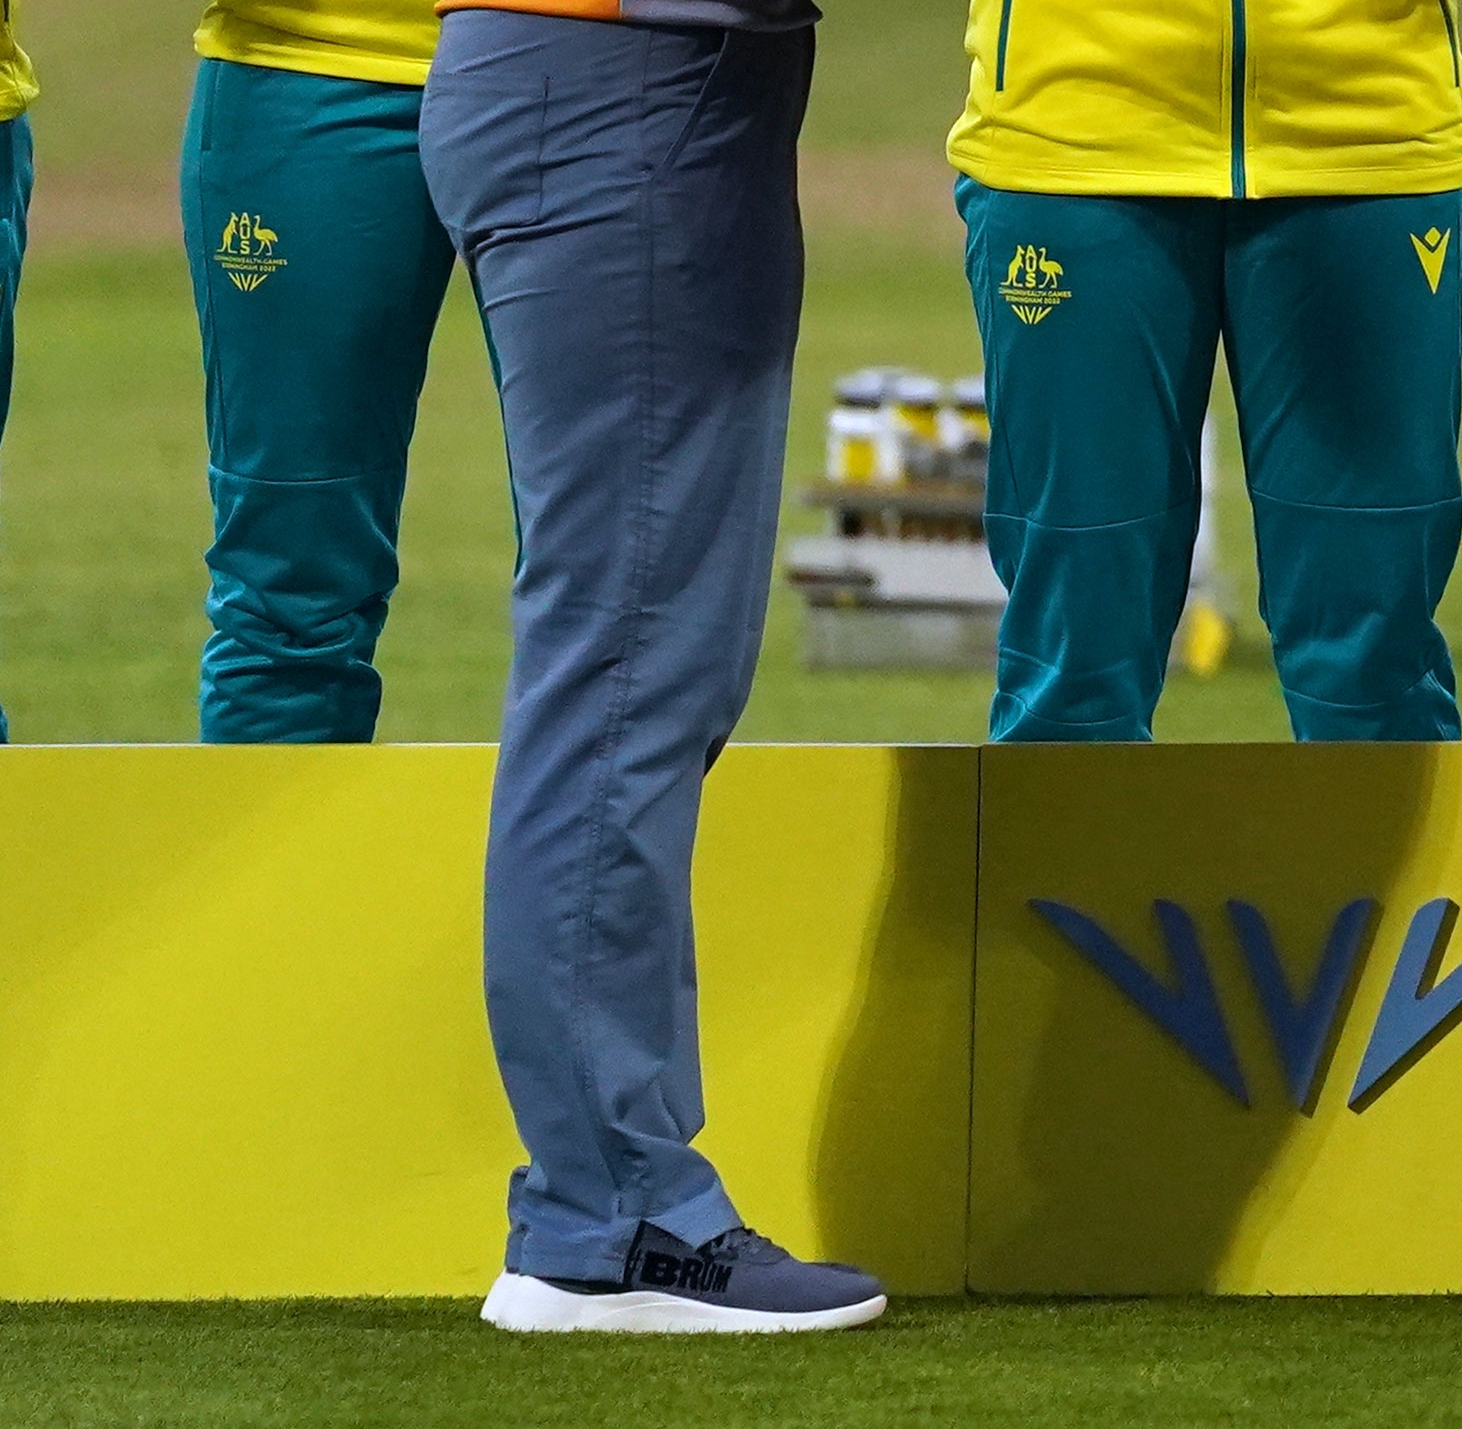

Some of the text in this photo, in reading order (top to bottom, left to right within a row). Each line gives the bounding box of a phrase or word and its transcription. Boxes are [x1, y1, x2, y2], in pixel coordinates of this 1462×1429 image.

[239, 212, 251, 255] AUS
[1025, 244, 1037, 288] AUS
[639, 1250, 733, 1293] BRUM
